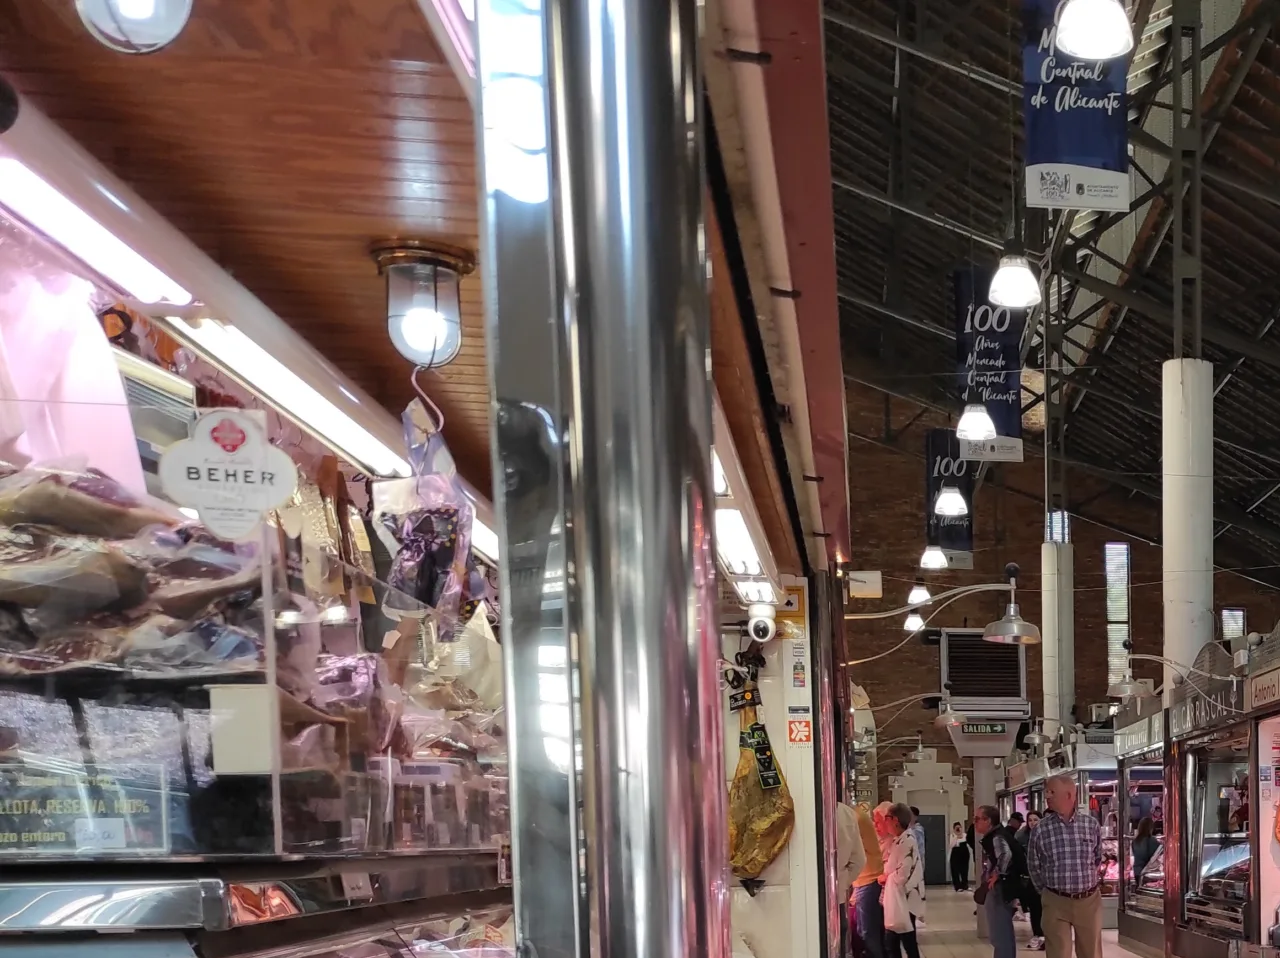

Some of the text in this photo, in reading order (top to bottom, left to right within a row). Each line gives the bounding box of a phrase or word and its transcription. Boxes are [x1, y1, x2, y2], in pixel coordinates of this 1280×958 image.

[1041, 57, 1103, 84] Central
[1031, 86, 1121, 115] de Alicante
[964, 302, 1011, 333] 100
[975, 335, 1000, 350] Años
[966, 351, 1006, 368] Mercado
[968, 369, 1006, 386] Central
[187, 466, 275, 485] BEHER
[933, 455, 967, 477] 100
[1254, 679, 1277, 702] Antonio
[1182, 691, 1227, 729] CARRASCAL
[963, 724, 991, 733] SALIDA
[22, 831, 66, 842] entero
